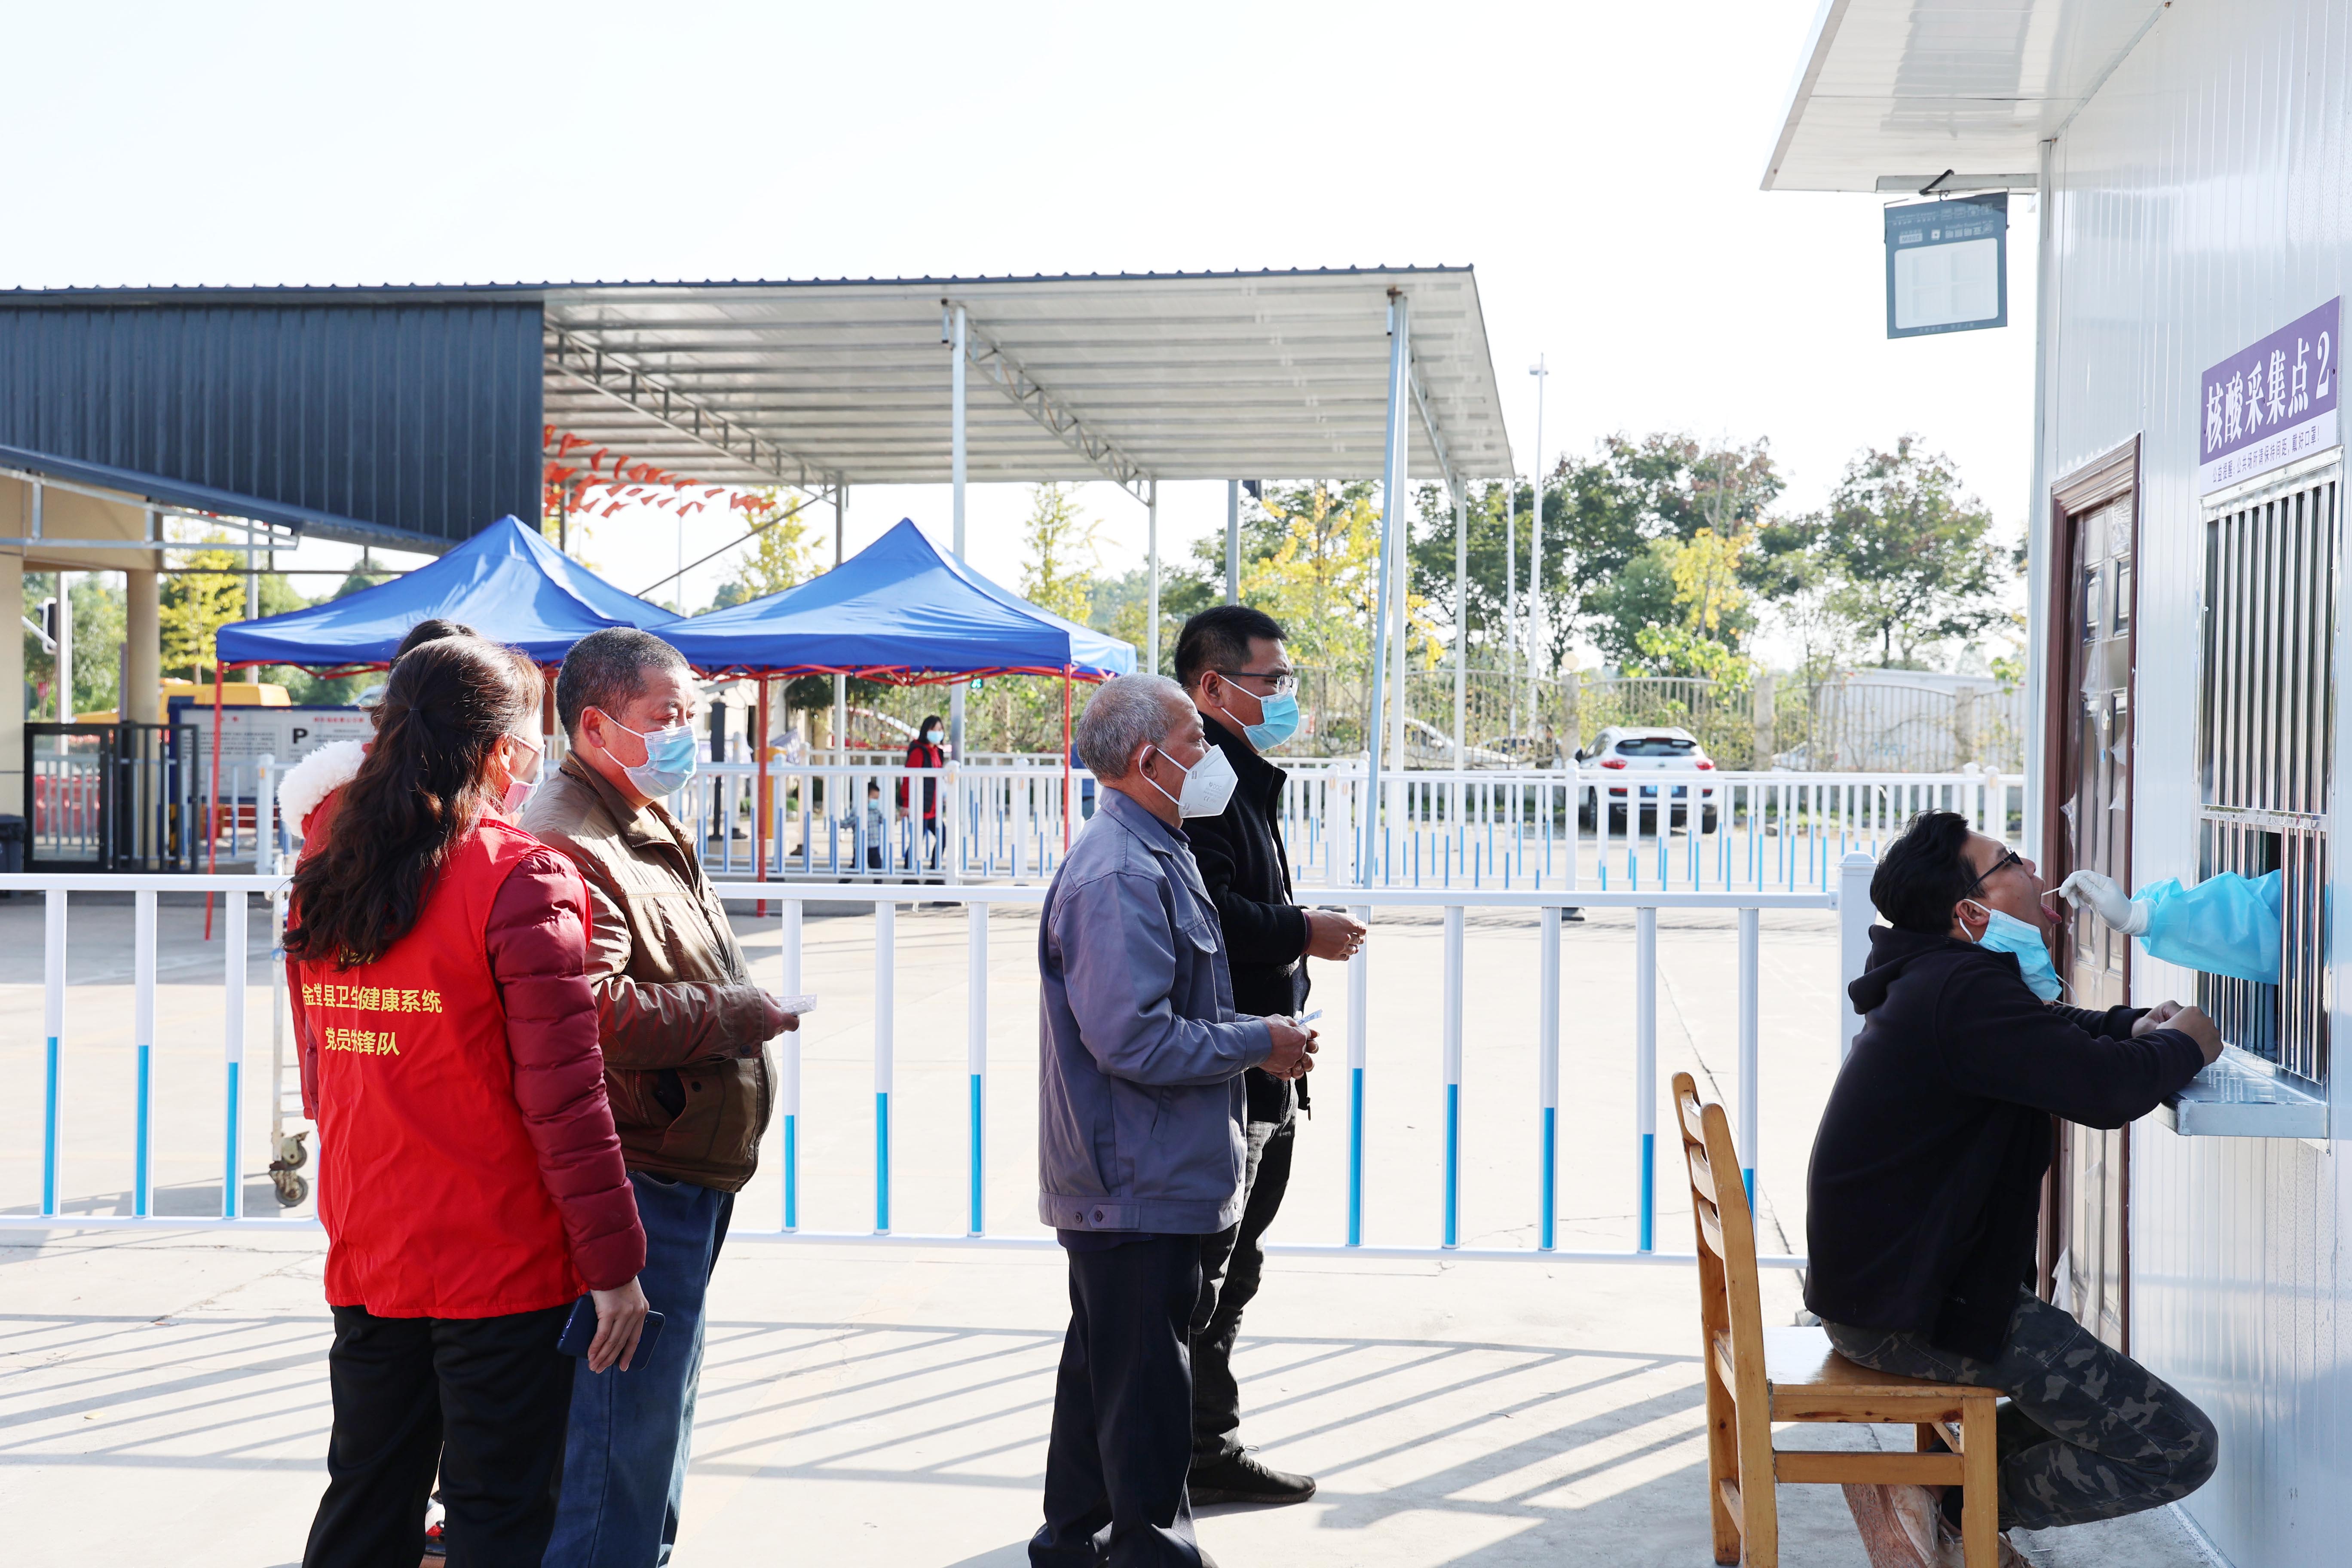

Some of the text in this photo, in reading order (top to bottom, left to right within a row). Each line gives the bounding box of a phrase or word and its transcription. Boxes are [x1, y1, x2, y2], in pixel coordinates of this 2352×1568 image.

[2205, 331, 2330, 454] 核酸采集点2
[293, 728, 308, 744] P
[302, 983, 443, 1013] 金堂县卫生健康系统
[325, 1026, 401, 1056] 党员先锋队
